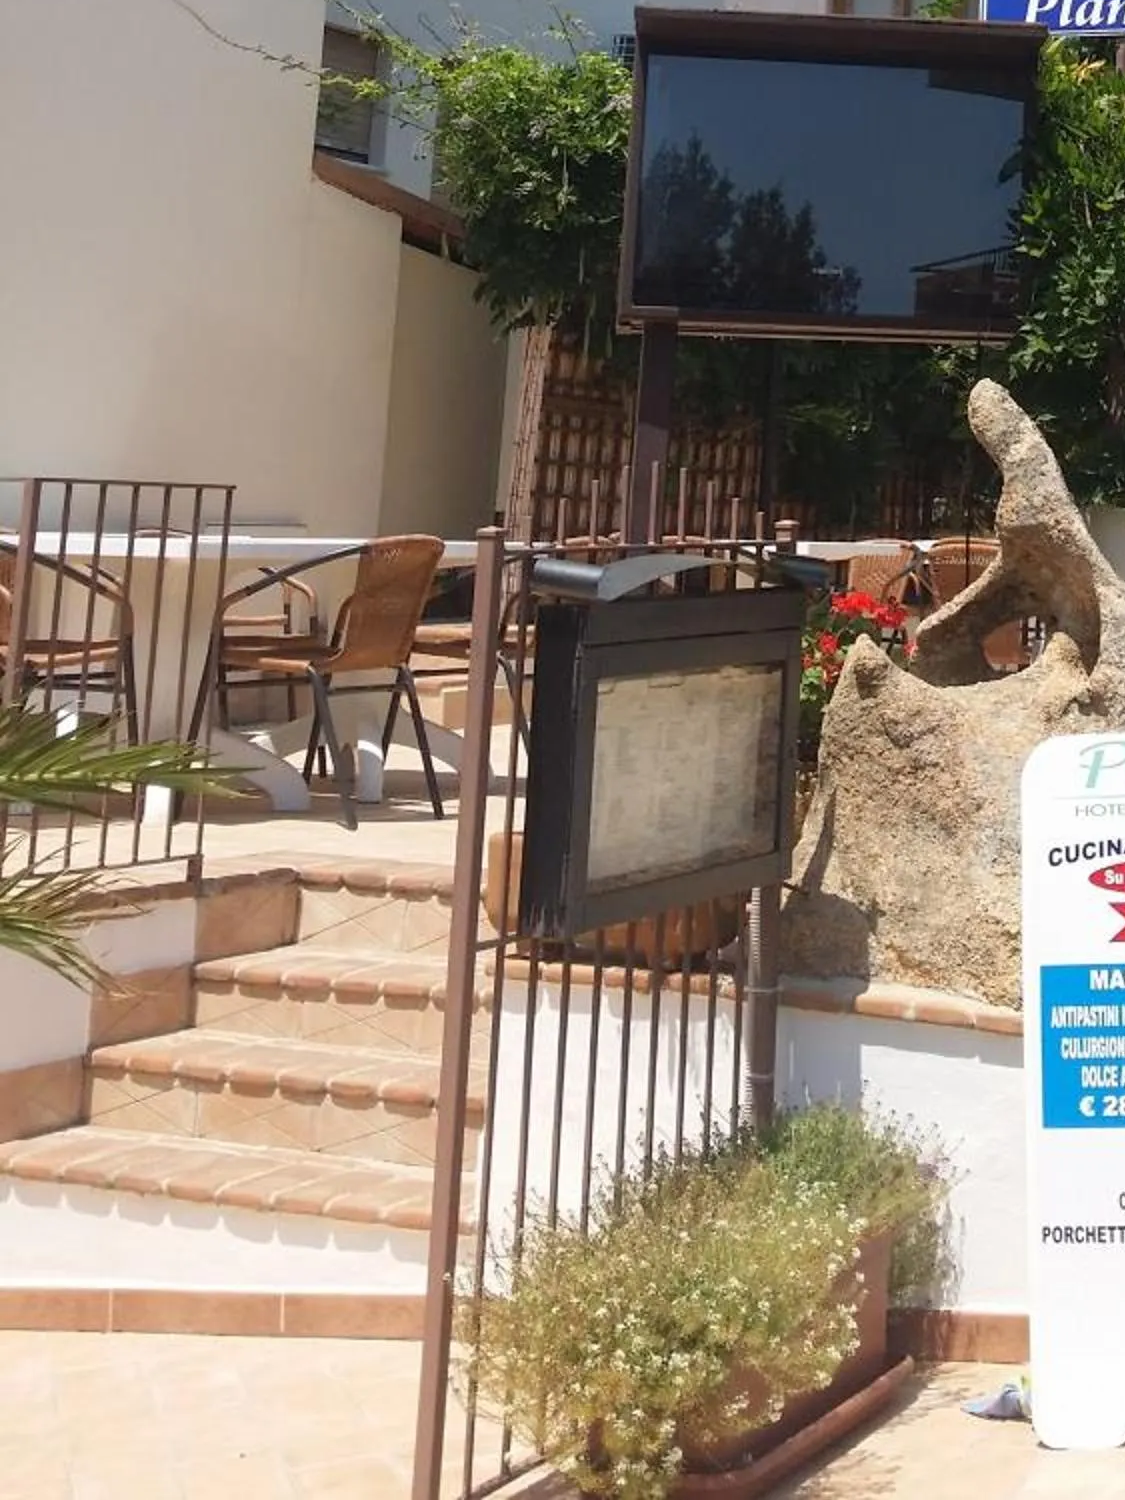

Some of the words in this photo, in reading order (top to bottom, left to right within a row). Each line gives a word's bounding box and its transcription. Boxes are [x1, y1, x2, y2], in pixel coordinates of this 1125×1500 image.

[1104, 870, 1125, 884] Su
[1081, 1066, 1118, 1087] DOLCE
[1080, 1097, 1096, 1116] €
